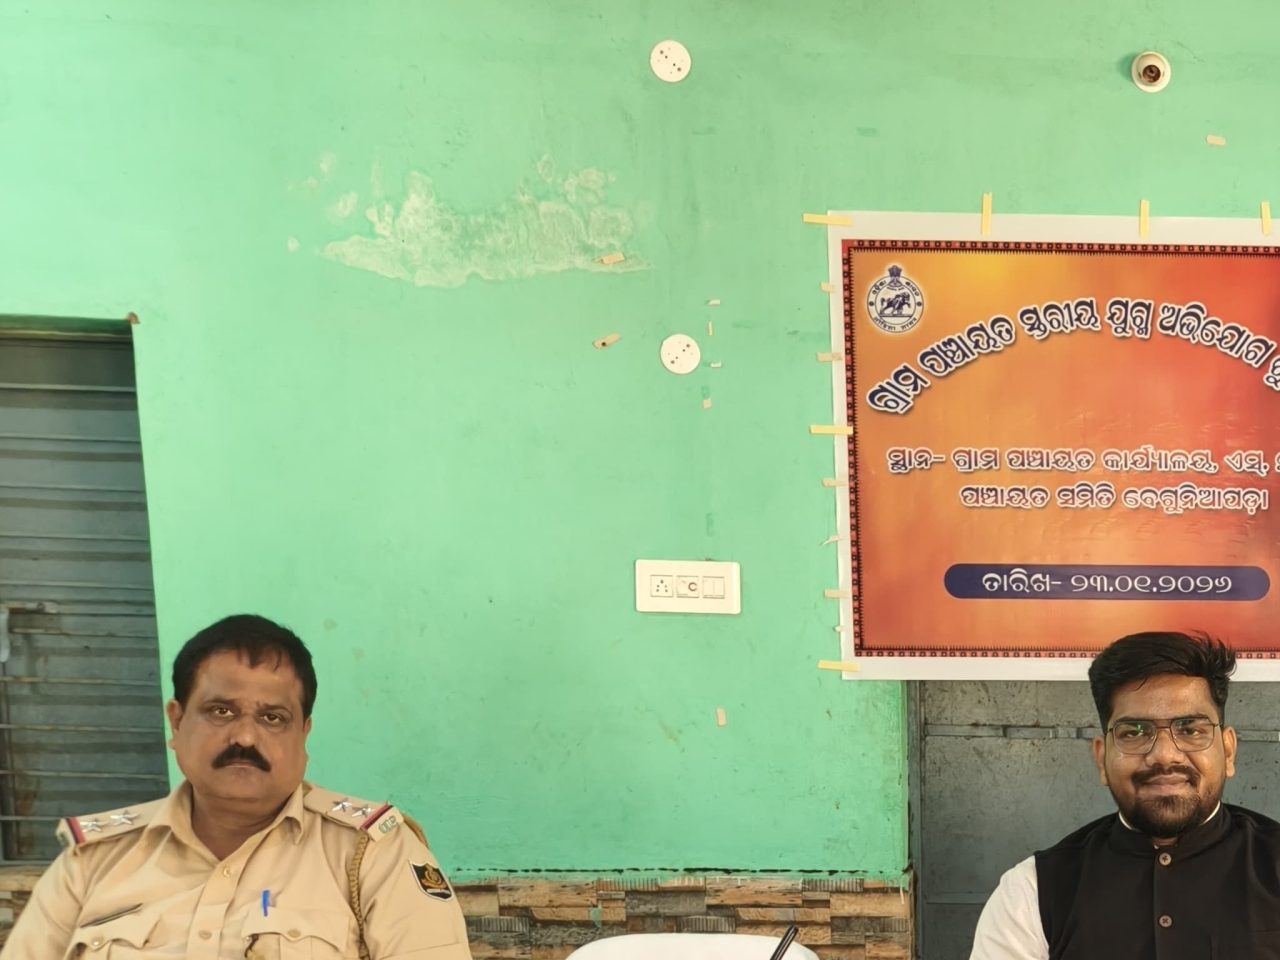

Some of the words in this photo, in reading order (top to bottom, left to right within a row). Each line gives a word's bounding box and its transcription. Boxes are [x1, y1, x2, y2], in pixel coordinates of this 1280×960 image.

[867, 363, 931, 414] ଗ୍ରାମ
[918, 314, 1016, 377] ପଞ୍ଚାୟତ
[1018, 297, 1100, 341] ସ୍ତରୀୟ
[1106, 298, 1153, 339] ଯୁଗ୍ମ
[1158, 301, 1278, 368] ଅଭିଯୋଗ
[952, 446, 1000, 473] ଗ୍ରାମ
[1006, 448, 1095, 473] ପଞ୍ଚାୟତ
[960, 485, 1049, 509] ପଞ୍ଚାୟତ
[1056, 481, 1115, 509] ସମିତି
